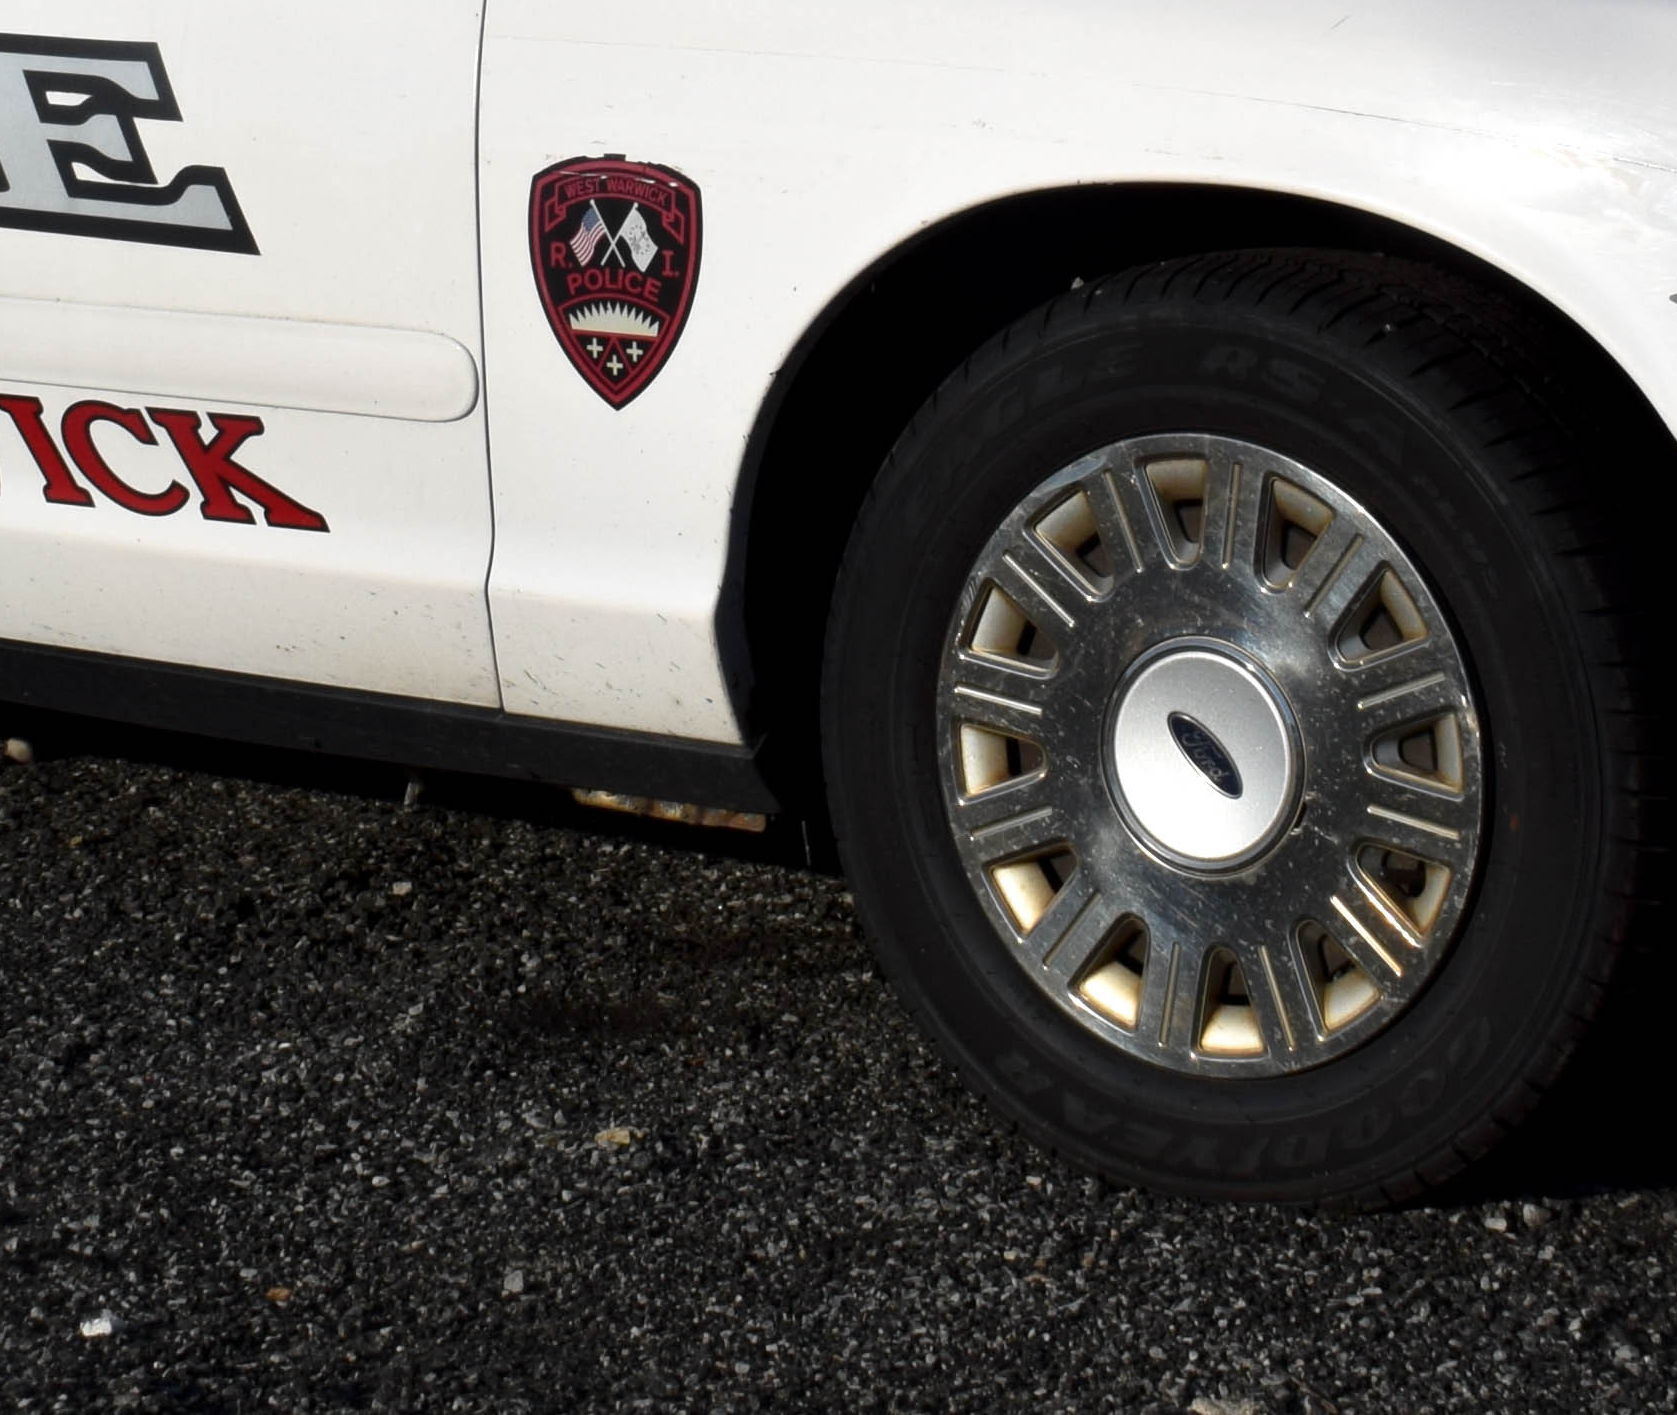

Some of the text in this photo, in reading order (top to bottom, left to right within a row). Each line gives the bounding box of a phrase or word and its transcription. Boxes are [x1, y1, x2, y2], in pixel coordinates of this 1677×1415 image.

[565, 177, 668, 206] WEST WARWICK
[566, 268, 662, 303] POLICE
